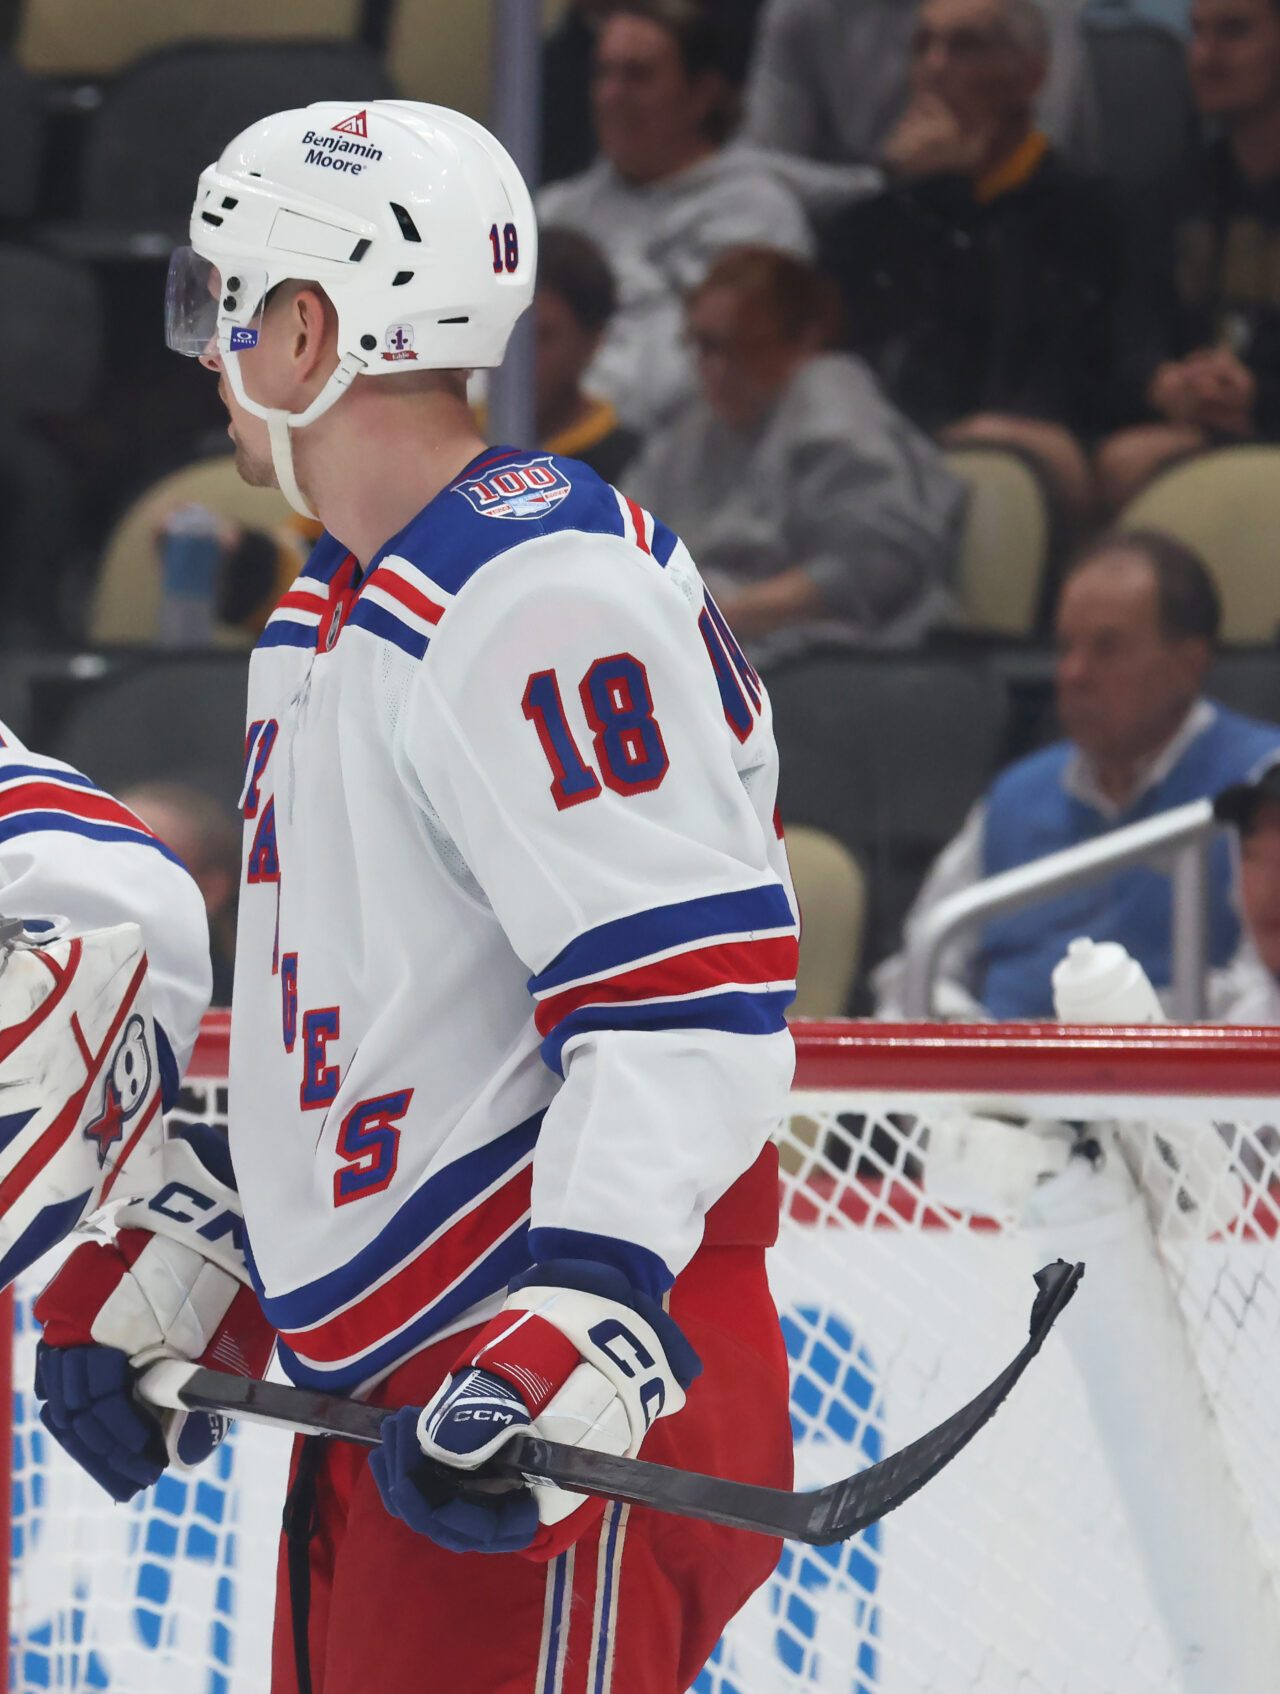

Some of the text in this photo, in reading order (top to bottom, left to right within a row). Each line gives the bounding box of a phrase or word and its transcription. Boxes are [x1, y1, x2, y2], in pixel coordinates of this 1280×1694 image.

[302, 131, 383, 161] Benjamin
[304, 149, 362, 175] Moore
[489, 222, 519, 274] 18
[468, 466, 557, 505] 100
[521, 652, 669, 811] 18
[454, 1410, 513, 1425] CCM
